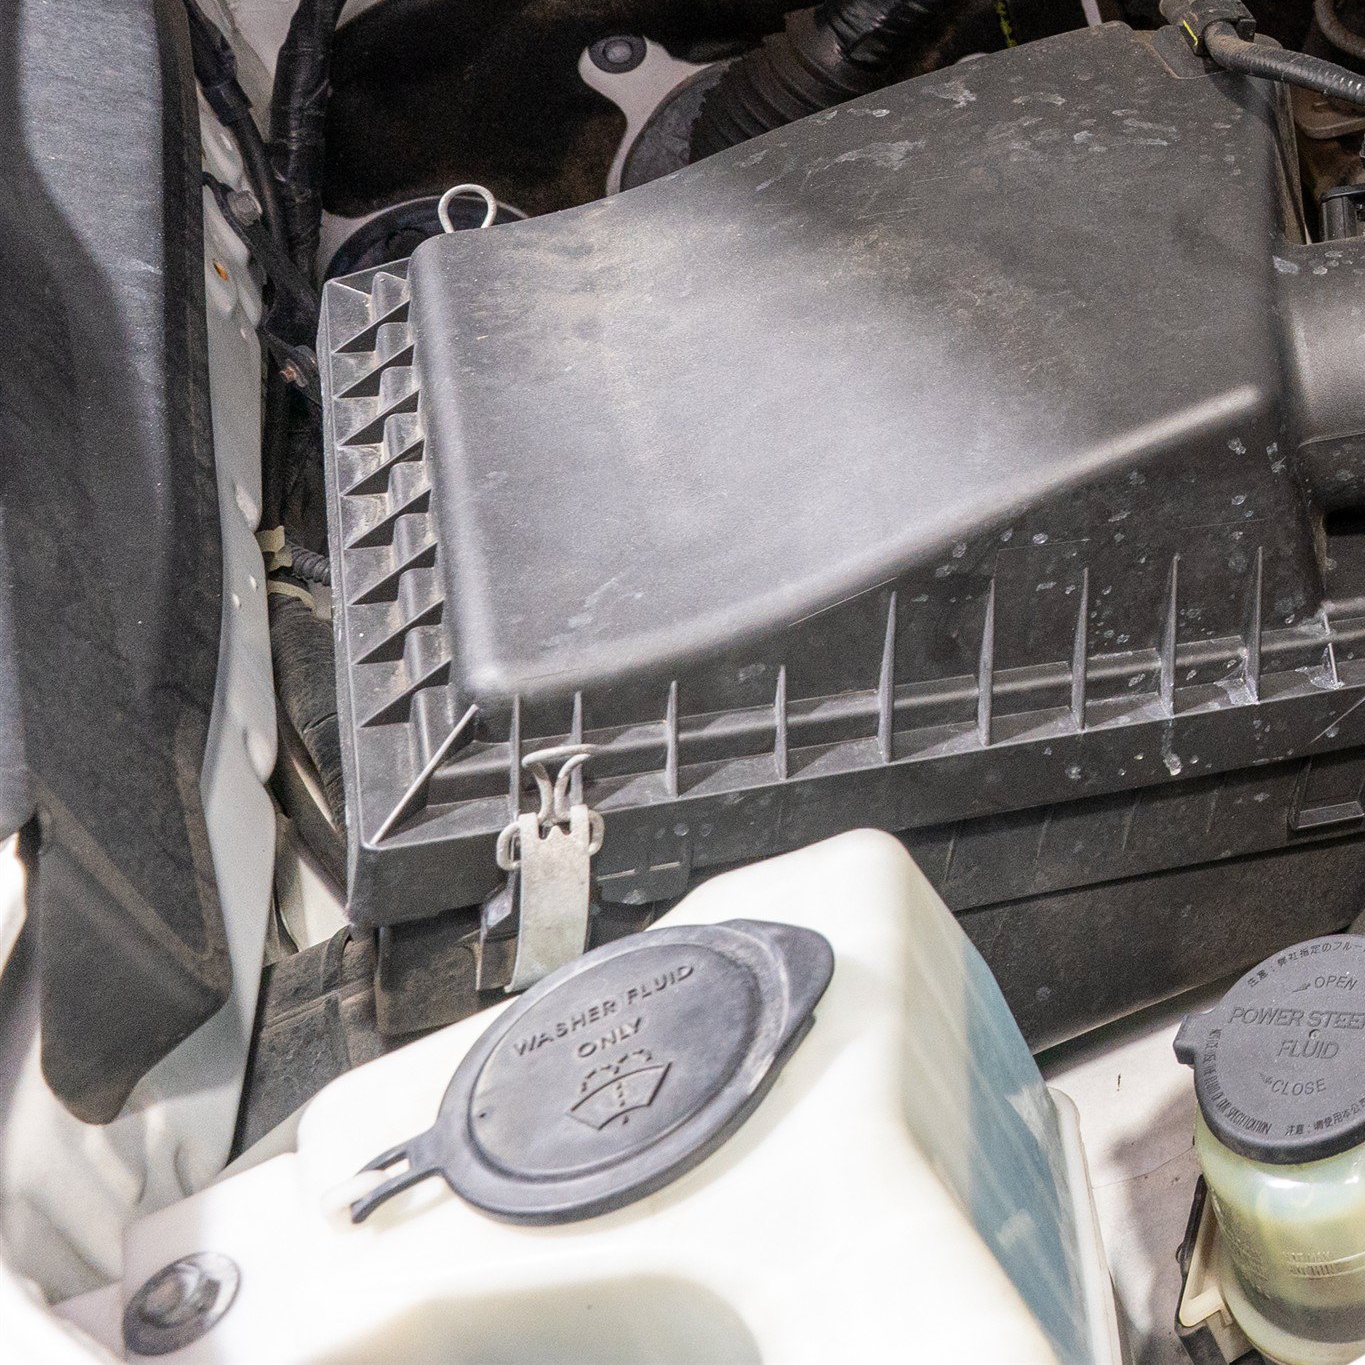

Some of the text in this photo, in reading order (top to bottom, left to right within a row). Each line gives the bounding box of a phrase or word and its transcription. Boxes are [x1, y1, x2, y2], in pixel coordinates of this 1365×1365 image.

[1313, 974, 1359, 992] OPEN
[513, 965, 694, 1056] WASHER FLUID
[1227, 1006, 1304, 1028] POWER
[575, 1016, 645, 1059] ONLY
[1275, 1039, 1340, 1060] FLUID
[1270, 1077, 1327, 1097] CLOSE
